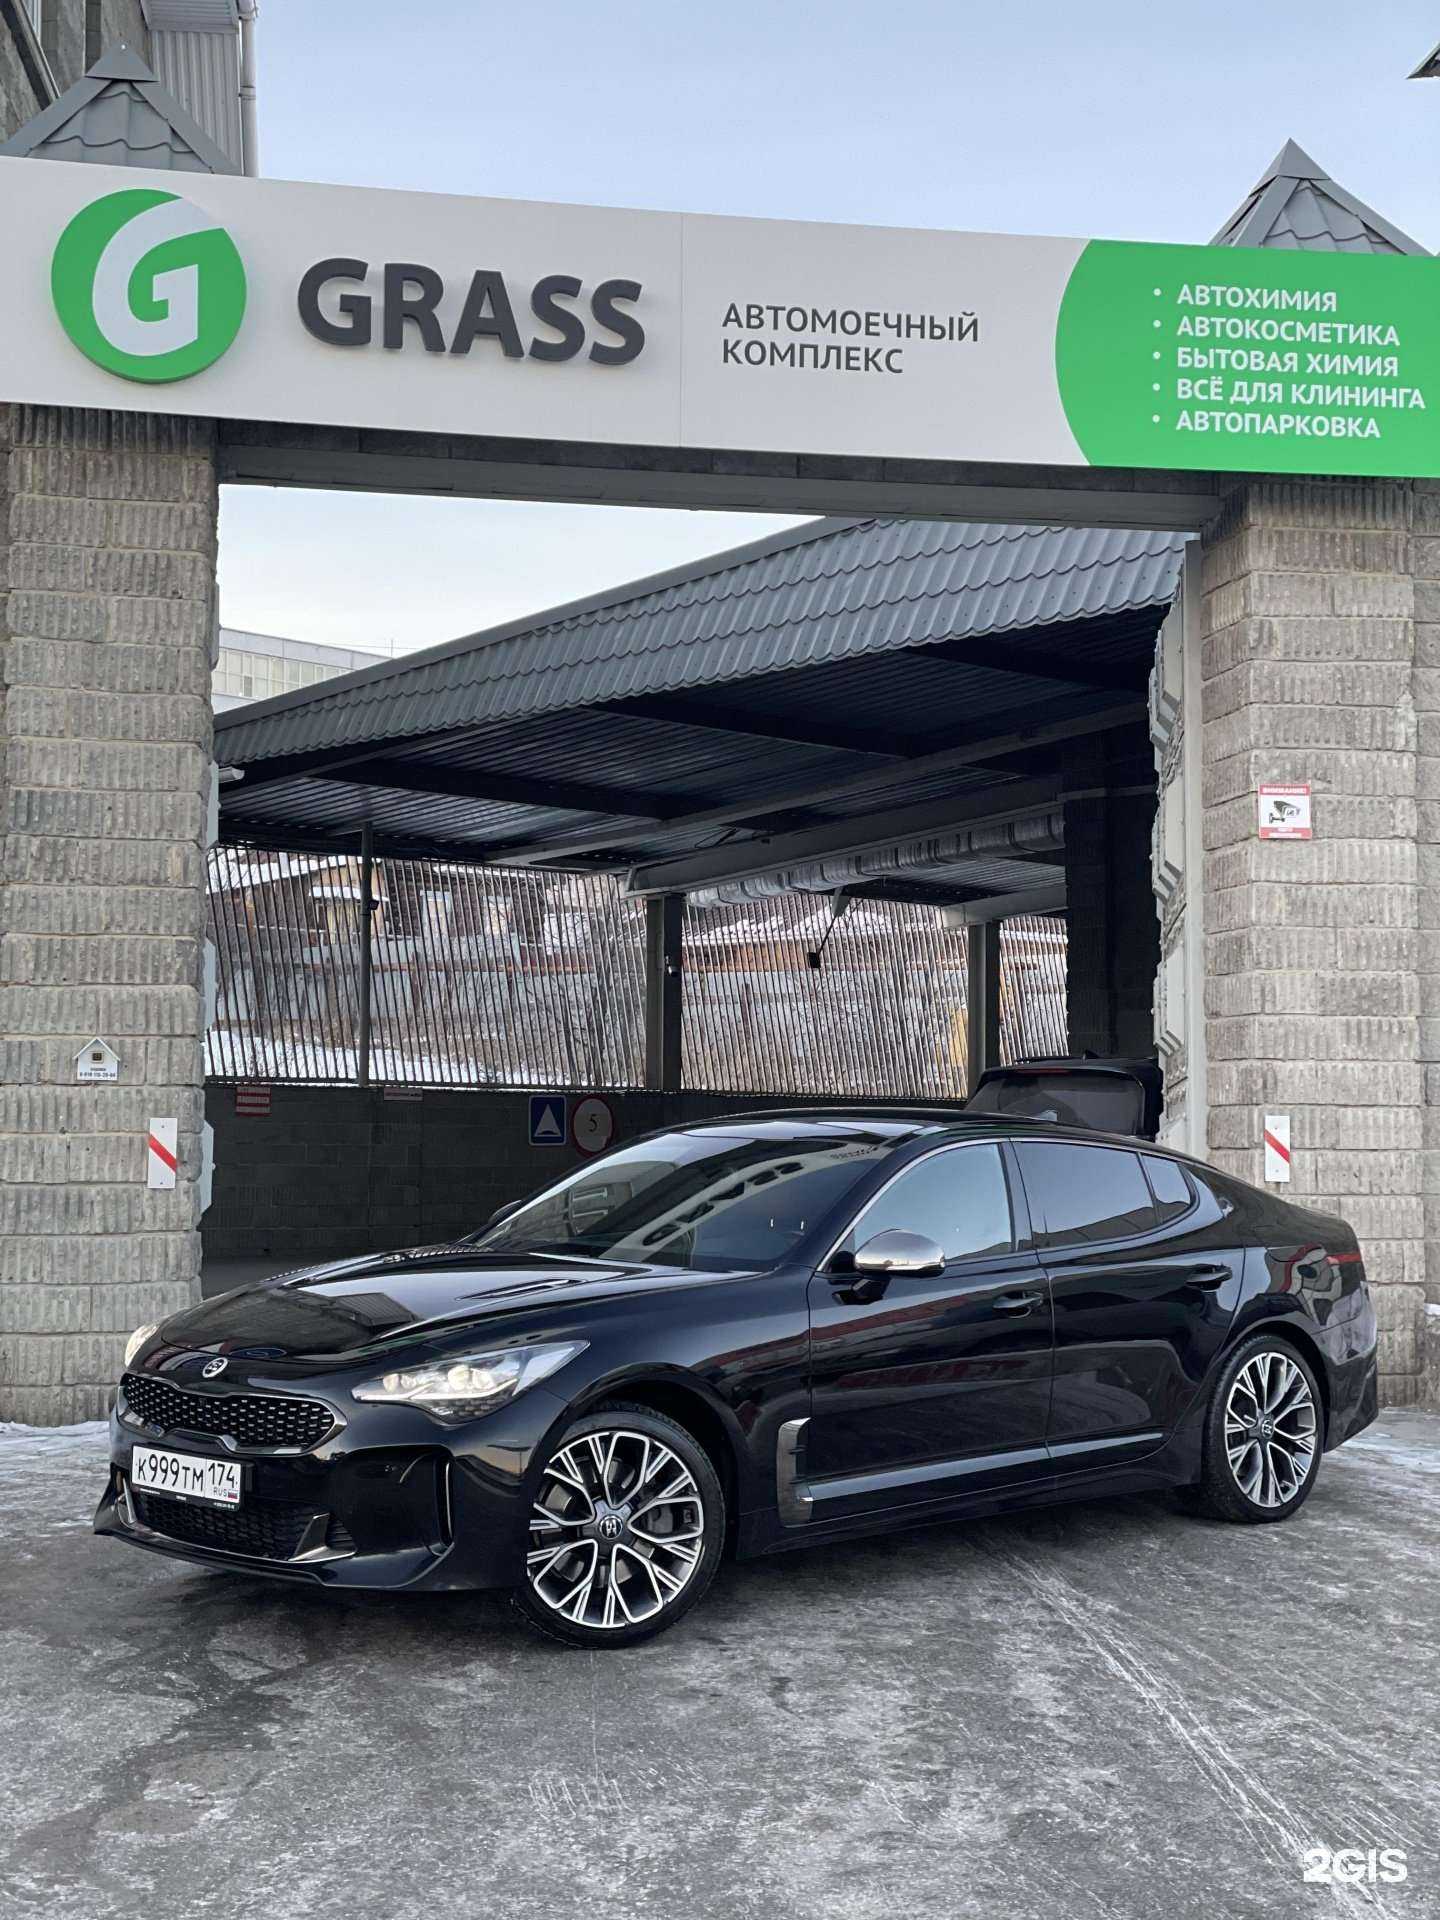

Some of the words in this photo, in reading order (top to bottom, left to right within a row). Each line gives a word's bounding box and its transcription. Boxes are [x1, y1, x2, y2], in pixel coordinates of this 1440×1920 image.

[297, 258, 646, 366] GRASS
[1176, 283, 1338, 313] АВТОХИМИЯ
[721, 302, 980, 342] АВТОМОЕЧНЫЙ
[1176, 314, 1401, 347] АВТОКОСМЕТИКА
[721, 338, 905, 374] КОМПЛЕКС
[1176, 345, 1300, 374] БЫТОВАЯ
[1304, 350, 1400, 378] ХИМИЯ
[1176, 374, 1224, 402] ВСЁ
[1229, 380, 1284, 407] ДЛЯ
[1289, 381, 1426, 410] КЛИНИНГА
[1176, 408, 1381, 439] АВТОПАРКОВКА
[587, 1113, 599, 1133] 5
[208, 1461, 236, 1489] 174
[213, 1485, 228, 1498] RUS
